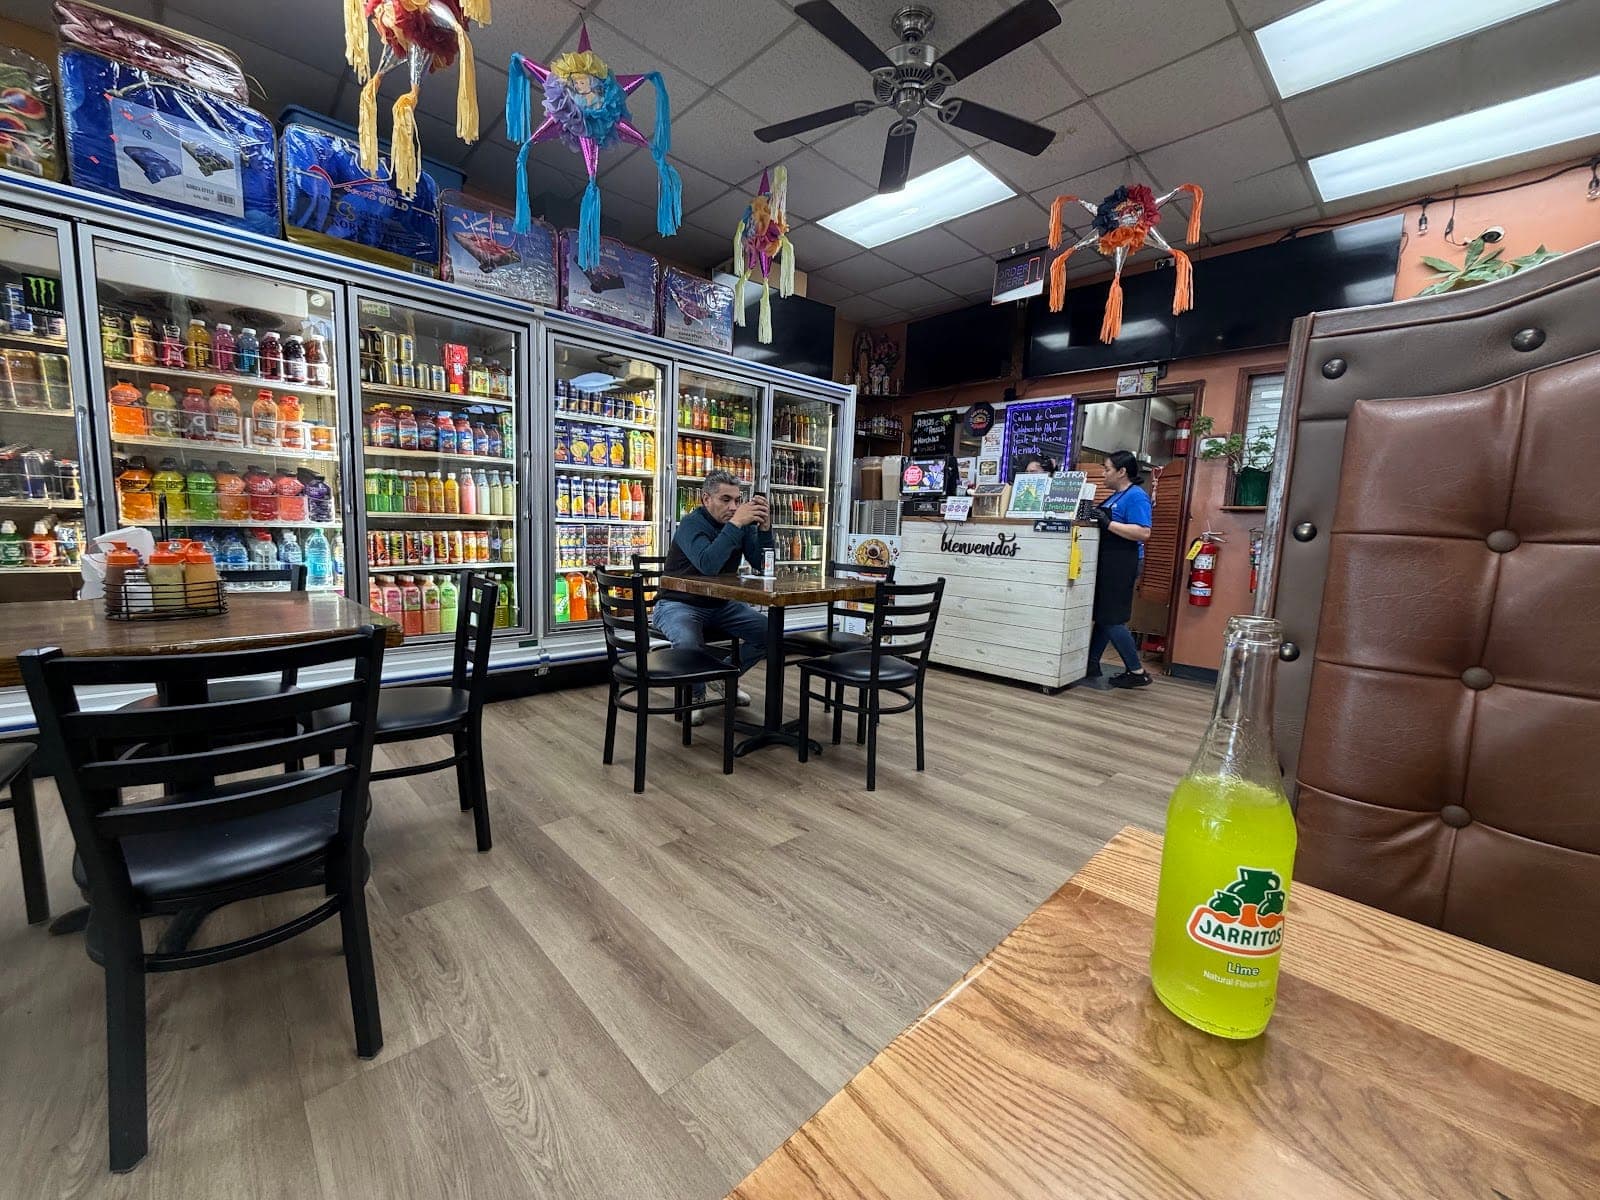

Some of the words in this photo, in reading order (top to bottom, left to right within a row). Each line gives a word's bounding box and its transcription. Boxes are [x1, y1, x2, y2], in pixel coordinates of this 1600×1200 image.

[998, 263, 1029, 280] ORDER
[1000, 274, 1025, 289] HERE
[940, 531, 1022, 557] bienvenidos
[1199, 919, 1282, 947] JARRITOS
[1203, 969, 1234, 986] Natural
[1227, 961, 1260, 977] Lime
